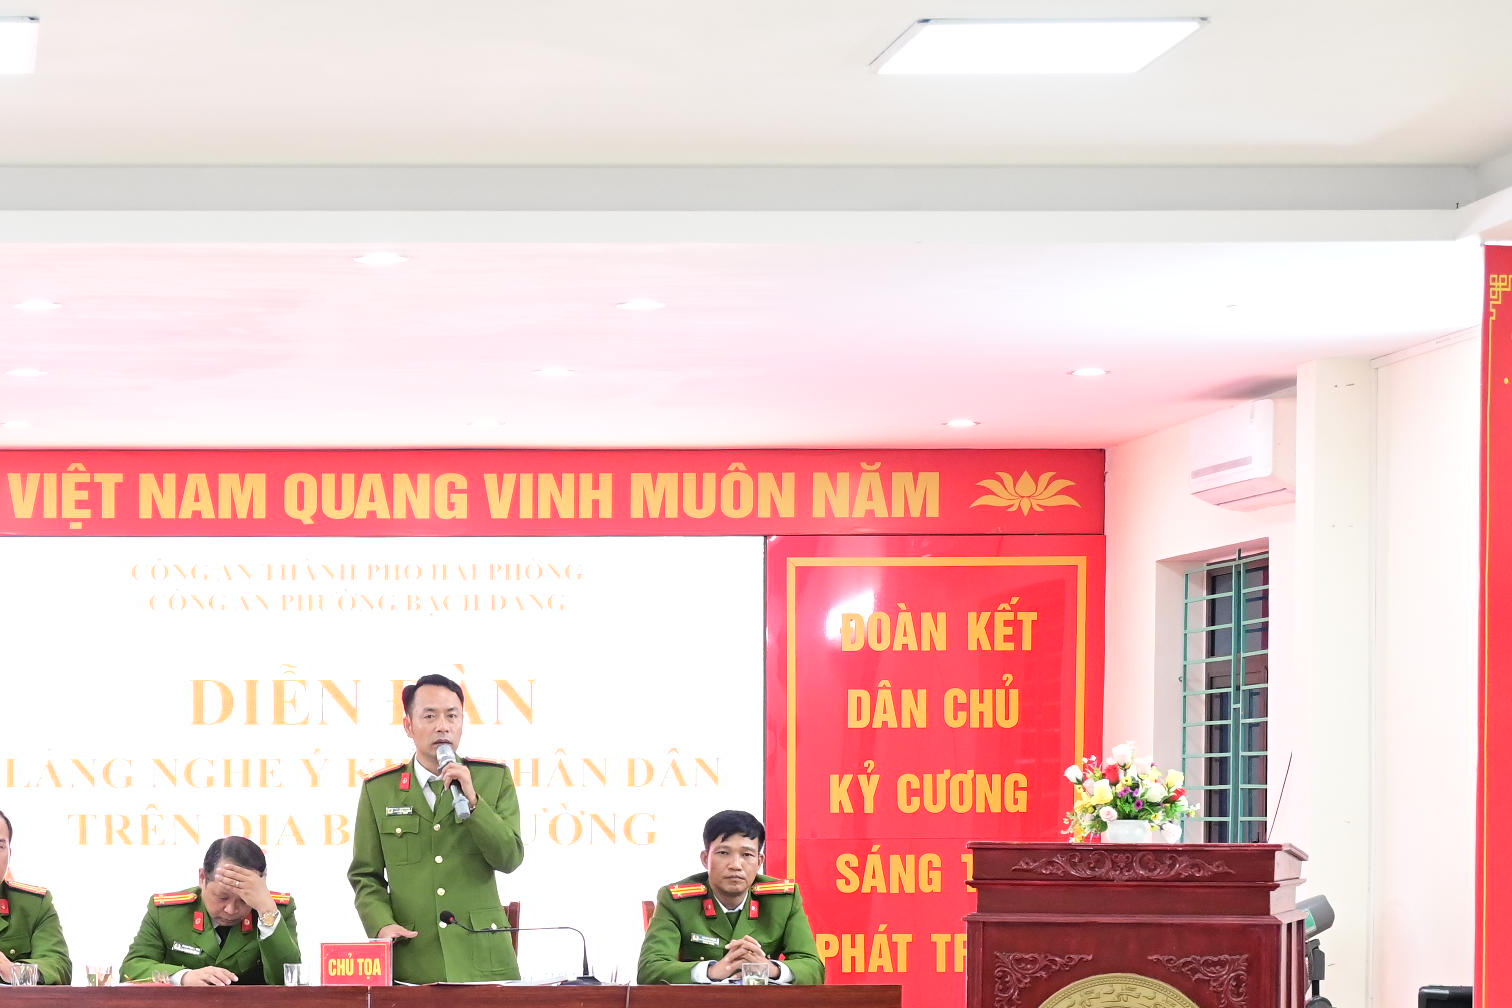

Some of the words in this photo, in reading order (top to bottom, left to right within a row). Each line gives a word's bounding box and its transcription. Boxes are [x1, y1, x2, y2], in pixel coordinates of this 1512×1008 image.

[7, 463, 123, 529] VIỆT
[140, 474, 266, 518] NAM
[285, 473, 467, 524] QUANG
[484, 473, 612, 518] VINH
[632, 463, 795, 518] MUÔN
[813, 464, 939, 518] NĂM
[219, 564, 253, 580] AN
[241, 595, 269, 611] AN
[840, 603, 946, 651] ĐOÀN
[968, 597, 1037, 650] KẾT
[848, 680, 926, 728] DÂN
[945, 674, 1018, 728] CHỦ
[152, 758, 281, 788] NGHE
[512, 748, 607, 788] HÂN
[627, 748, 720, 787] DÂN
[831, 760, 880, 813] KỶ
[898, 769, 1027, 813] CƯƠNG
[68, 803, 200, 846] TRÊN
[836, 845, 941, 893] SÁNG
[328, 953, 355, 976] CHỦ
[357, 958, 382, 979] TỌA
[816, 924, 912, 972] PHÁT
